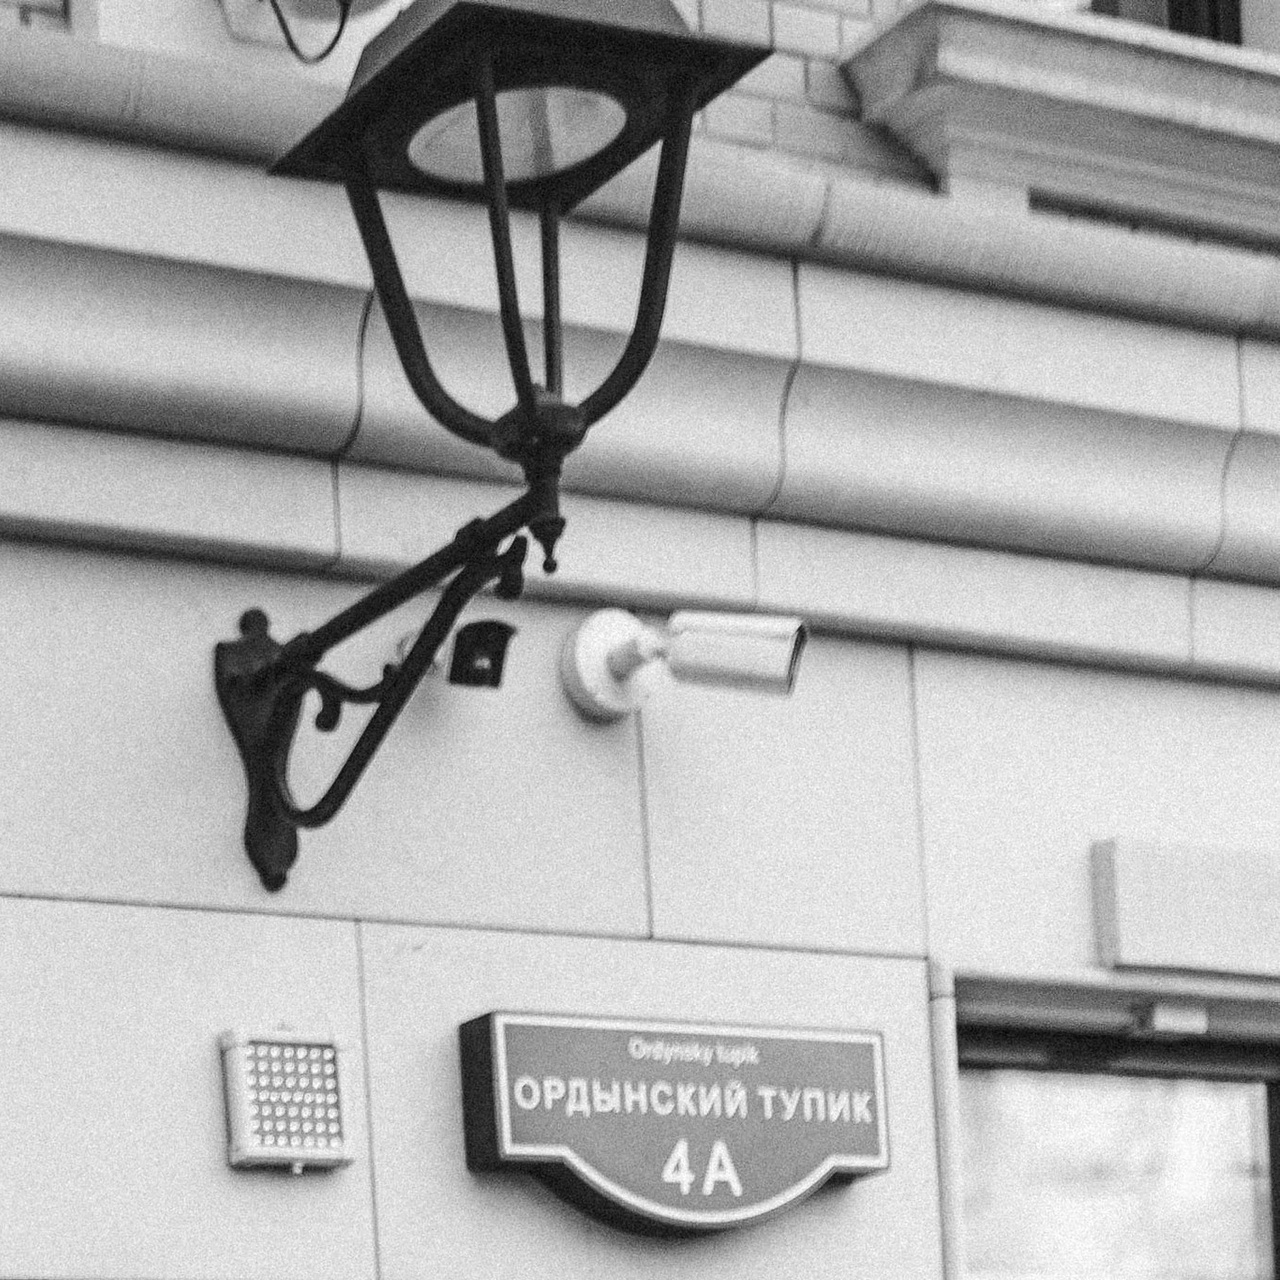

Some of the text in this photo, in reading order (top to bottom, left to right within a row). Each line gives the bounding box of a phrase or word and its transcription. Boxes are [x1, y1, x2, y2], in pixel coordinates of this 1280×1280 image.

[514, 1076, 872, 1124] ОРДЫНСКИЙ ТУПИК
[663, 1140, 744, 1197] 4А
